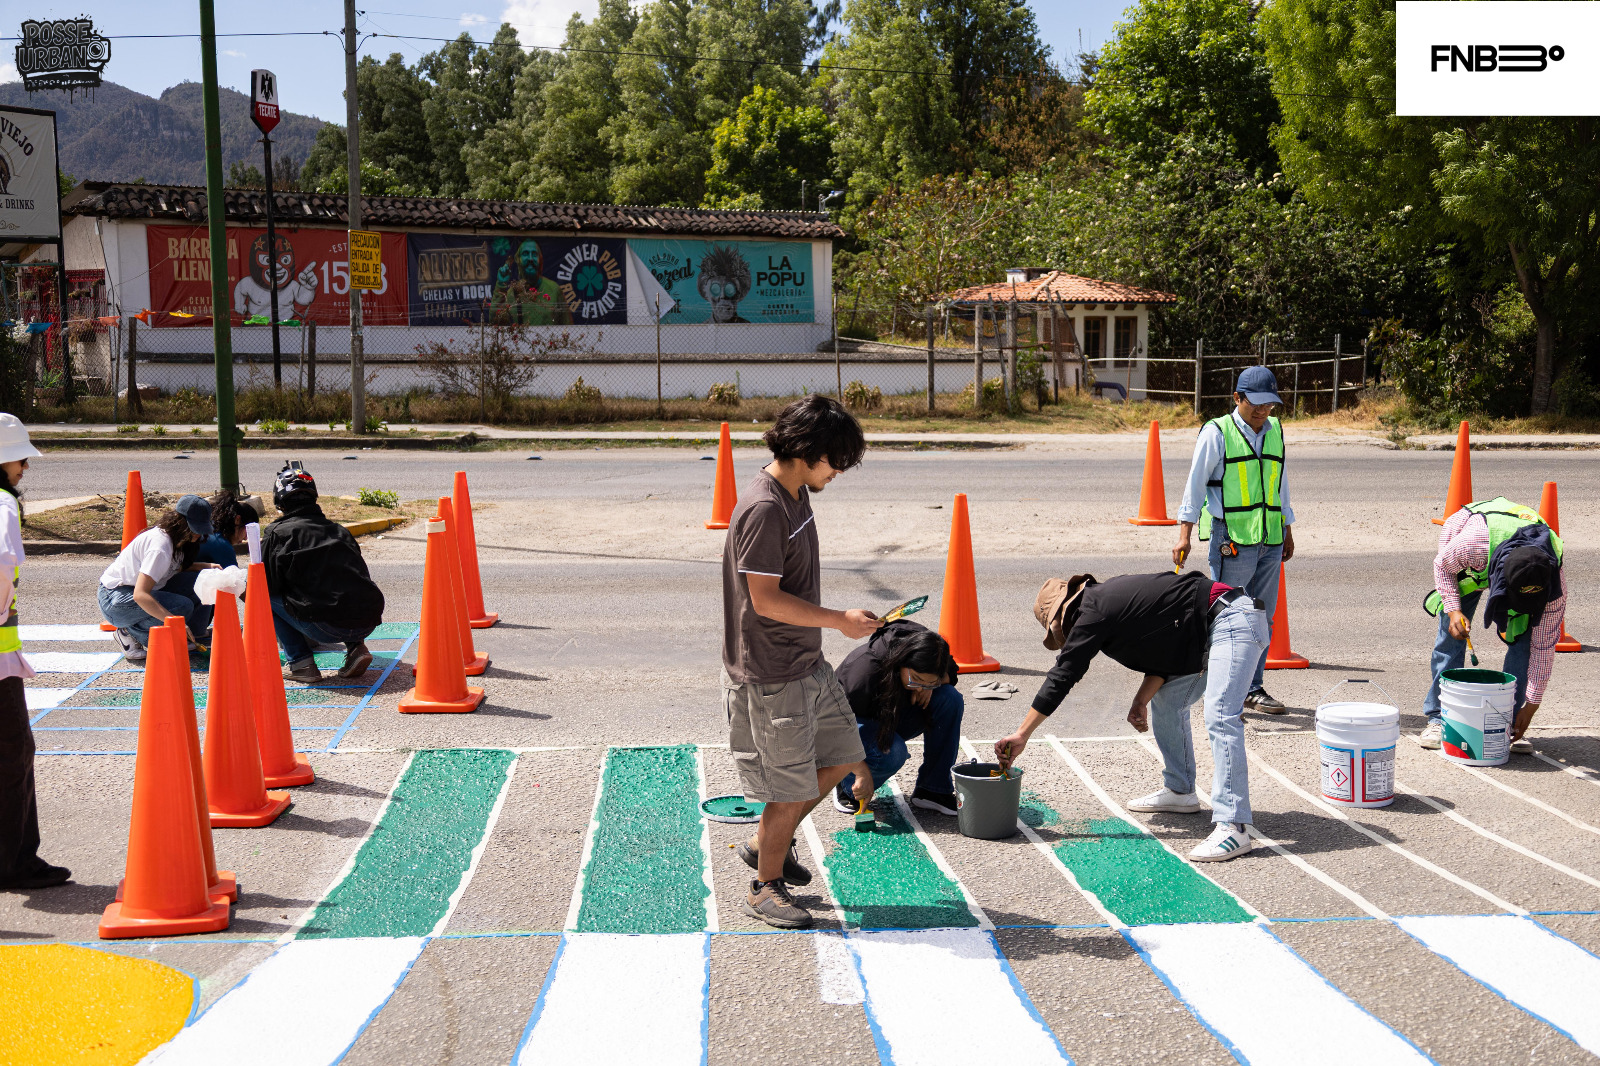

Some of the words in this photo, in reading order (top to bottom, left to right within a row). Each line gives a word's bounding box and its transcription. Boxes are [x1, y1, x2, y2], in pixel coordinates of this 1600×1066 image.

[258, 103, 277, 118] TECATE
[0, 117, 34, 156] VIEJO
[5, 199, 35, 210] DRINKS
[168, 237, 239, 259] BARRA
[351, 249, 373, 260] ENTRADA
[375, 251, 380, 261] Y
[351, 262, 370, 273] SALIDA
[372, 263, 380, 274] DE
[418, 252, 488, 281] ALITAS
[557, 244, 599, 281] CLOVER
[598, 249, 621, 280] PUB
[768, 255, 792, 270] LA
[756, 271, 805, 286] POPU
[422, 289, 453, 301] CHELAS
[455, 288, 460, 300] Y
[462, 284, 493, 299] ROCK
[560, 283, 582, 312] PUB
[581, 281, 622, 318] CLOVER
